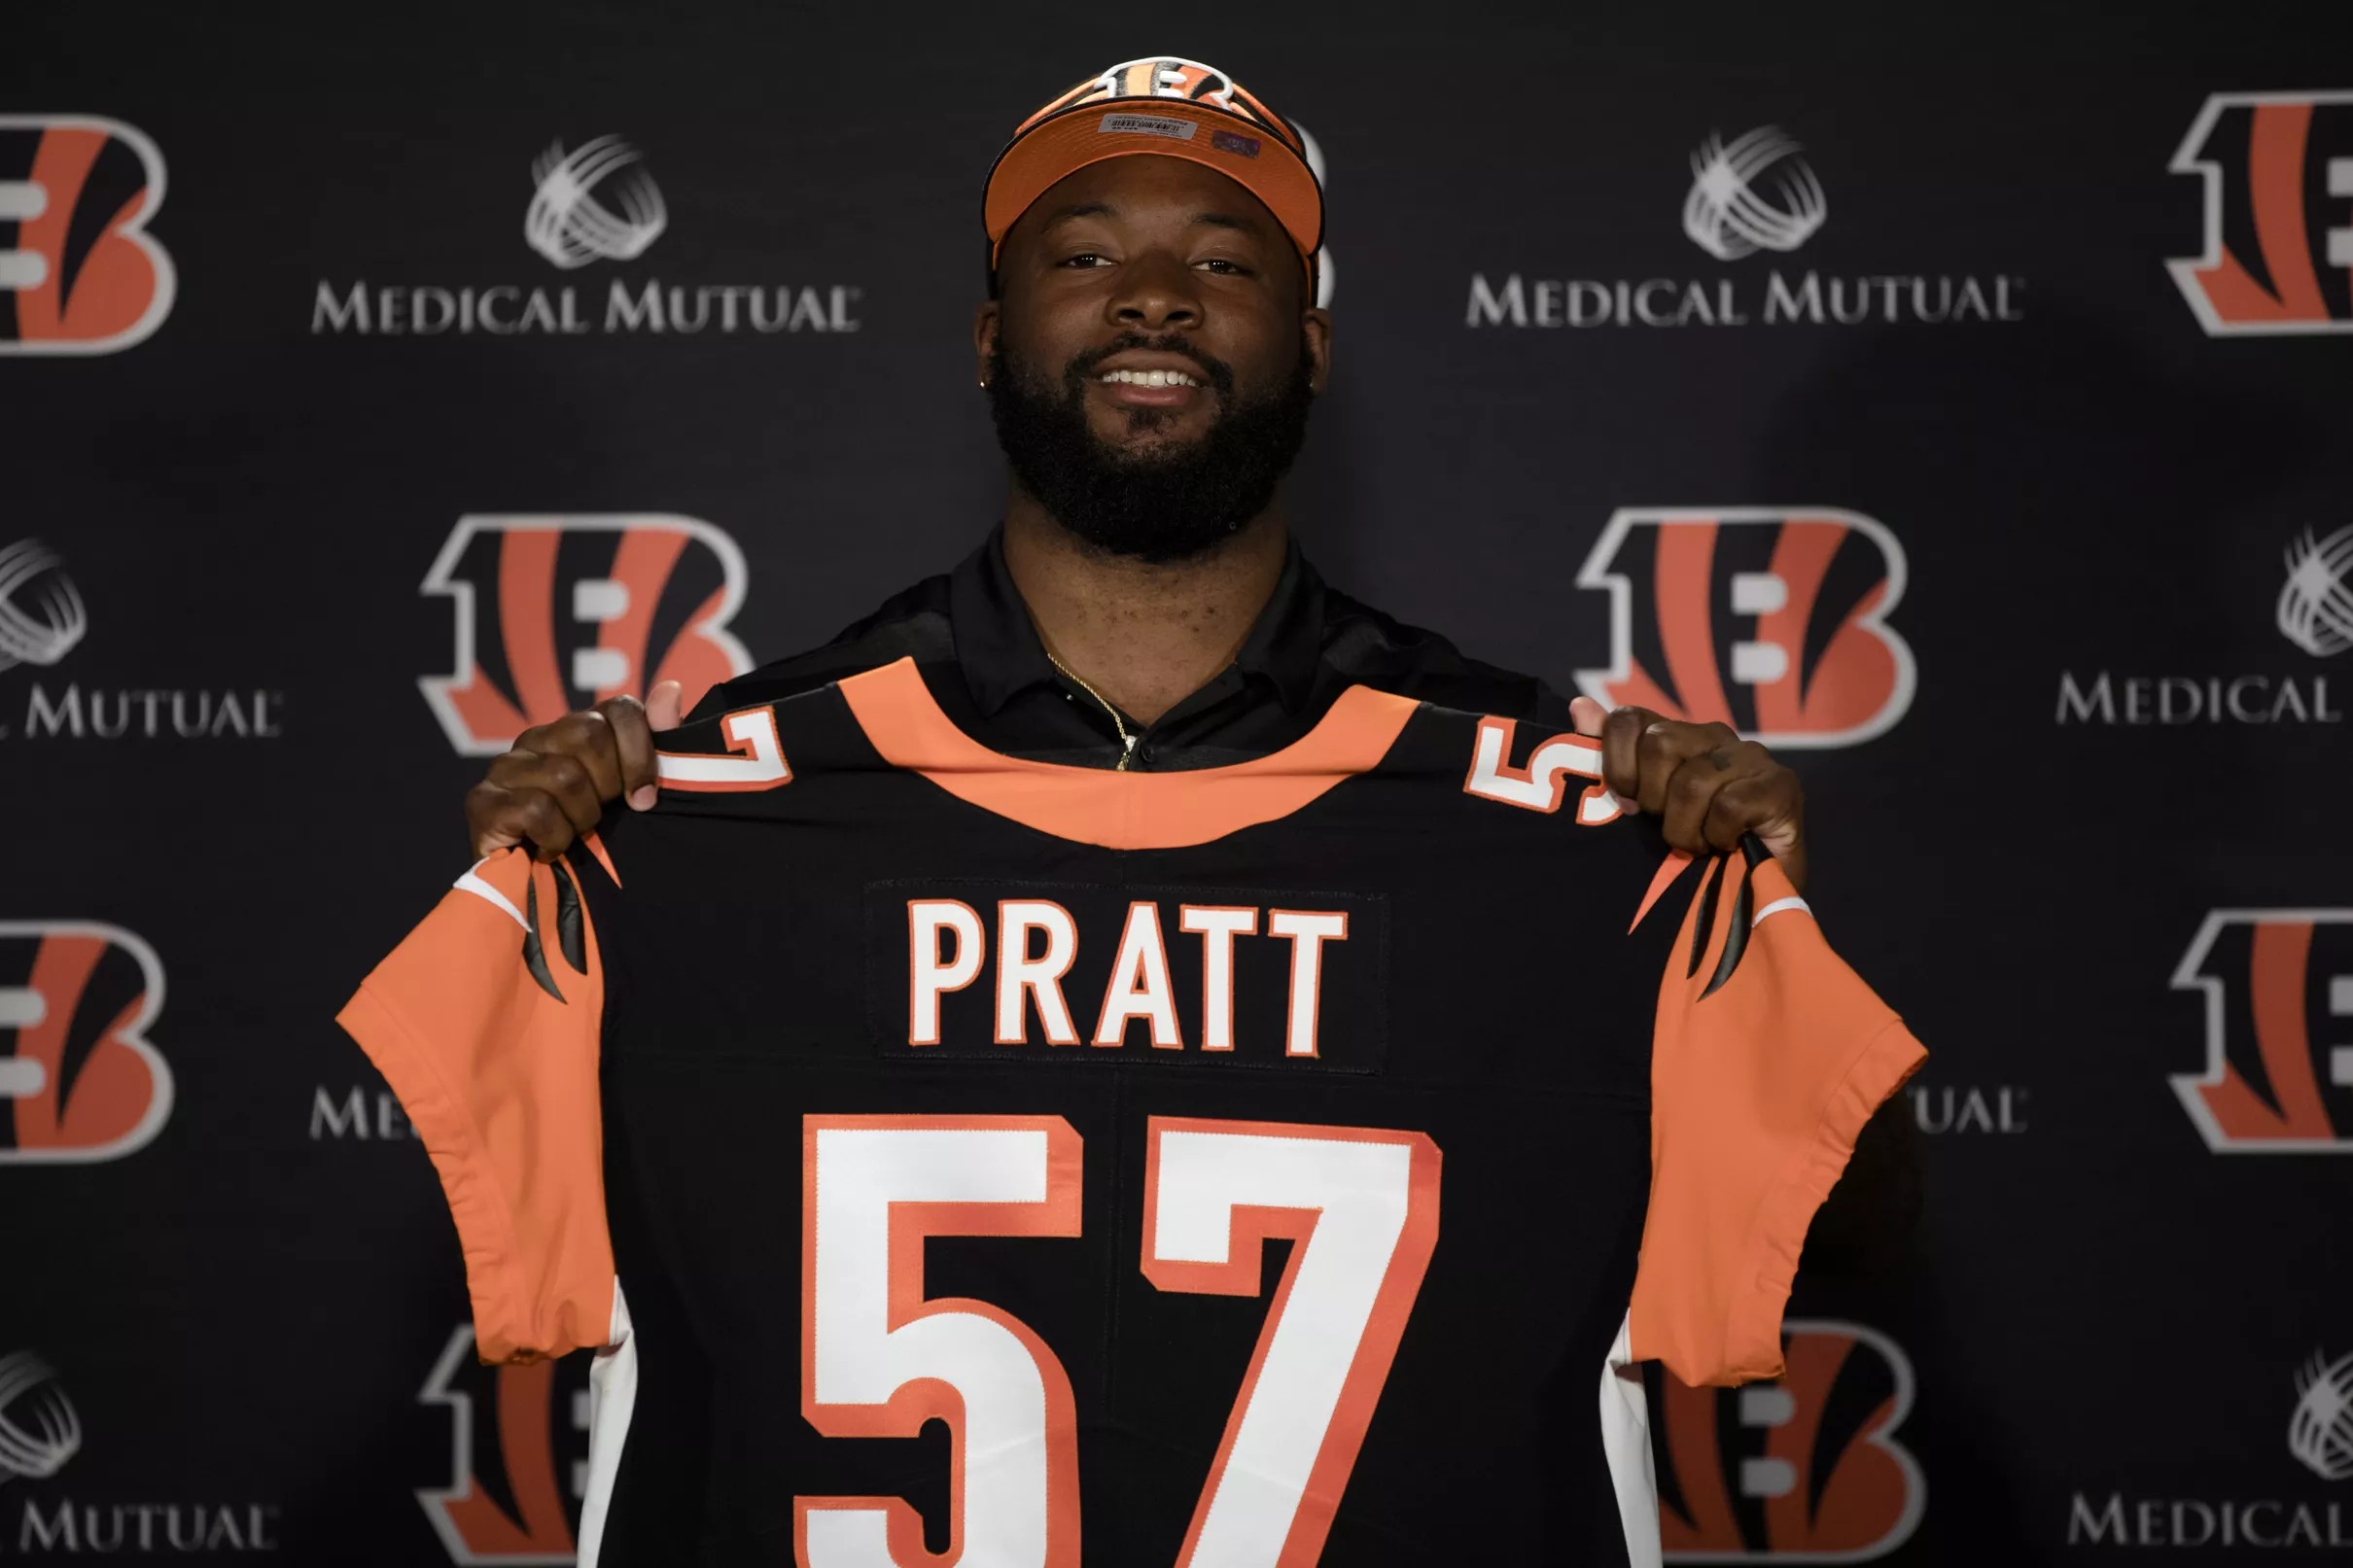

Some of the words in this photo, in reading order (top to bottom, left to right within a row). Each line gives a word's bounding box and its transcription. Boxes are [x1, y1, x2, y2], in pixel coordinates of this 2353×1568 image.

[310, 278, 589, 334] MEDICAL
[603, 278, 860, 333] MUTUAL
[1465, 270, 1746, 328] MEDICAL
[1763, 269, 2024, 326] MUTUAL
[24, 680, 282, 738] MUTUAL
[2055, 670, 2343, 724] MEDICAL
[907, 898, 1349, 1059] PRATT
[793, 1113, 1444, 1568] 57
[18, 1497, 280, 1552] MUTUAL
[2066, 1490, 2353, 1547] MEDICAL
